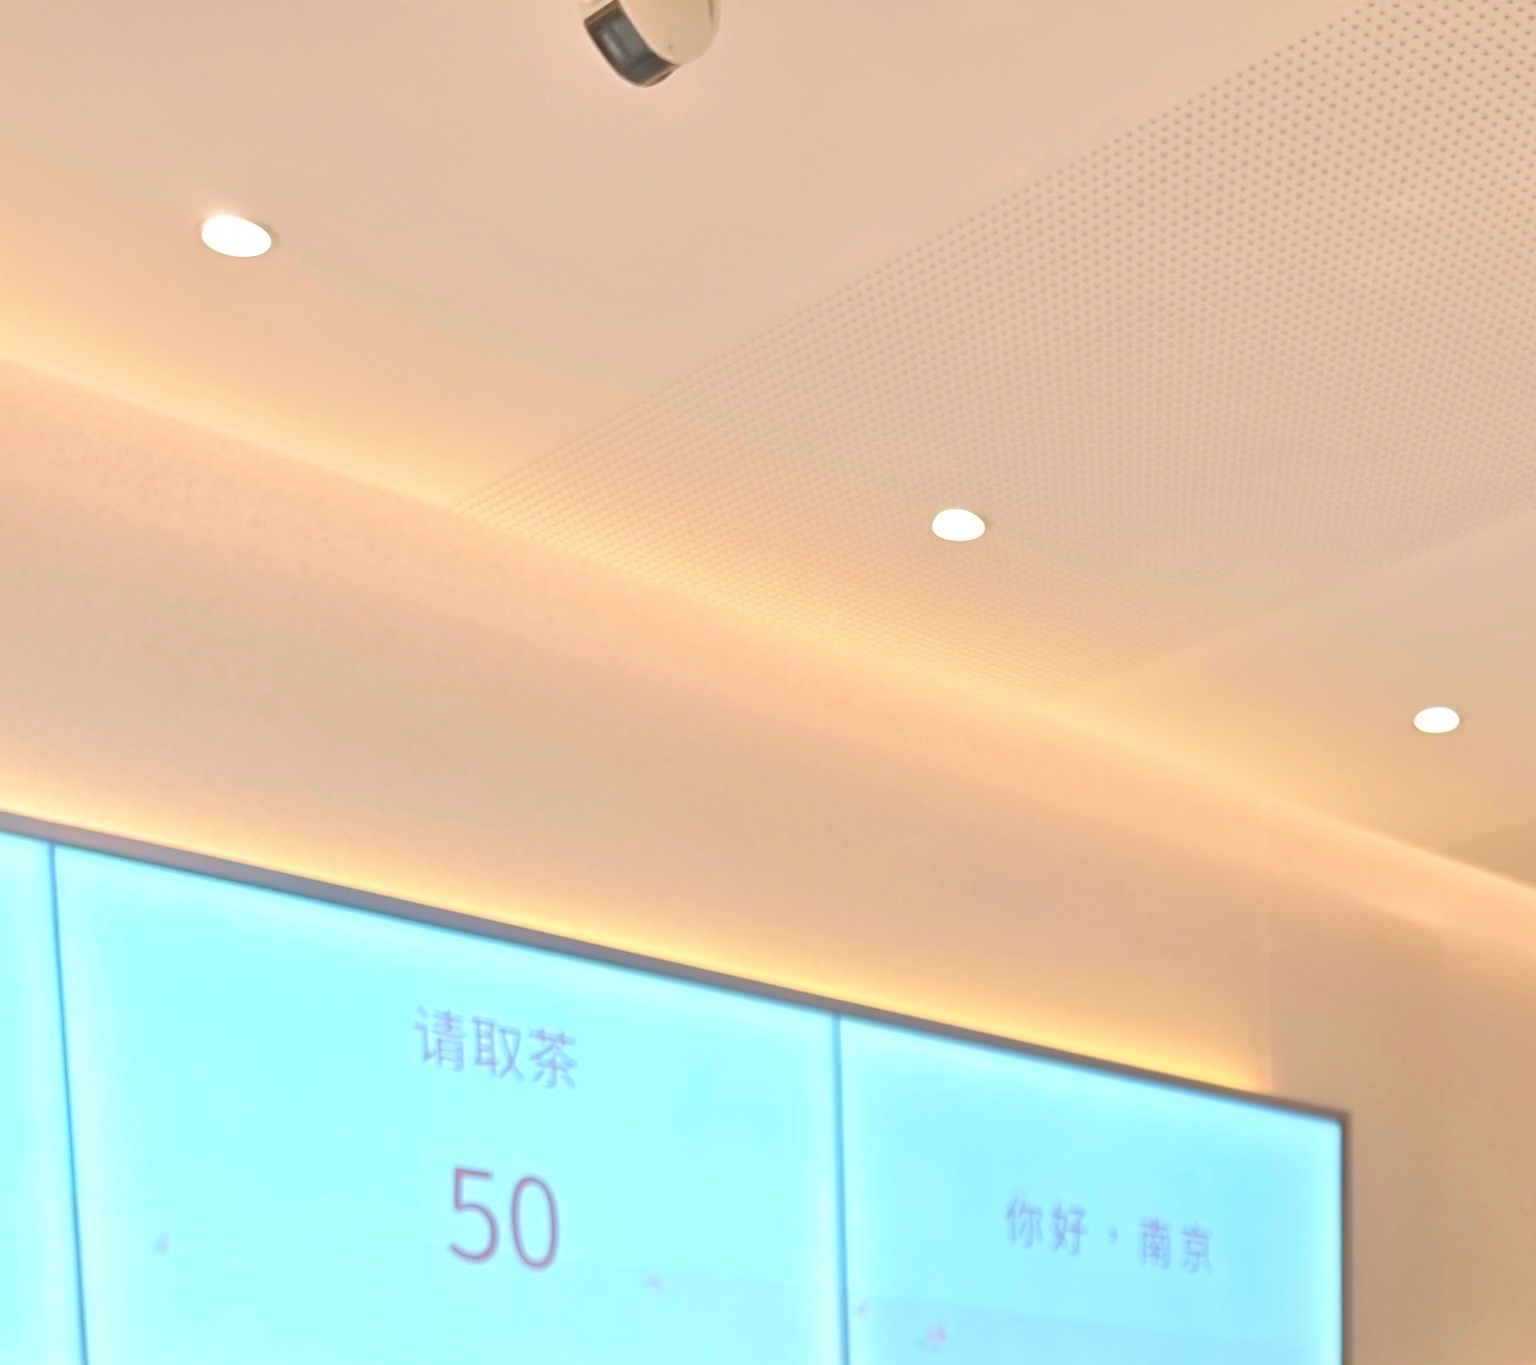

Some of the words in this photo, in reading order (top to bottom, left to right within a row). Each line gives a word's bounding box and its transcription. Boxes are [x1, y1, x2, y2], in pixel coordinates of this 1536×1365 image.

[413, 1004, 577, 1089] 请取茶
[450, 1166, 560, 1270] 50
